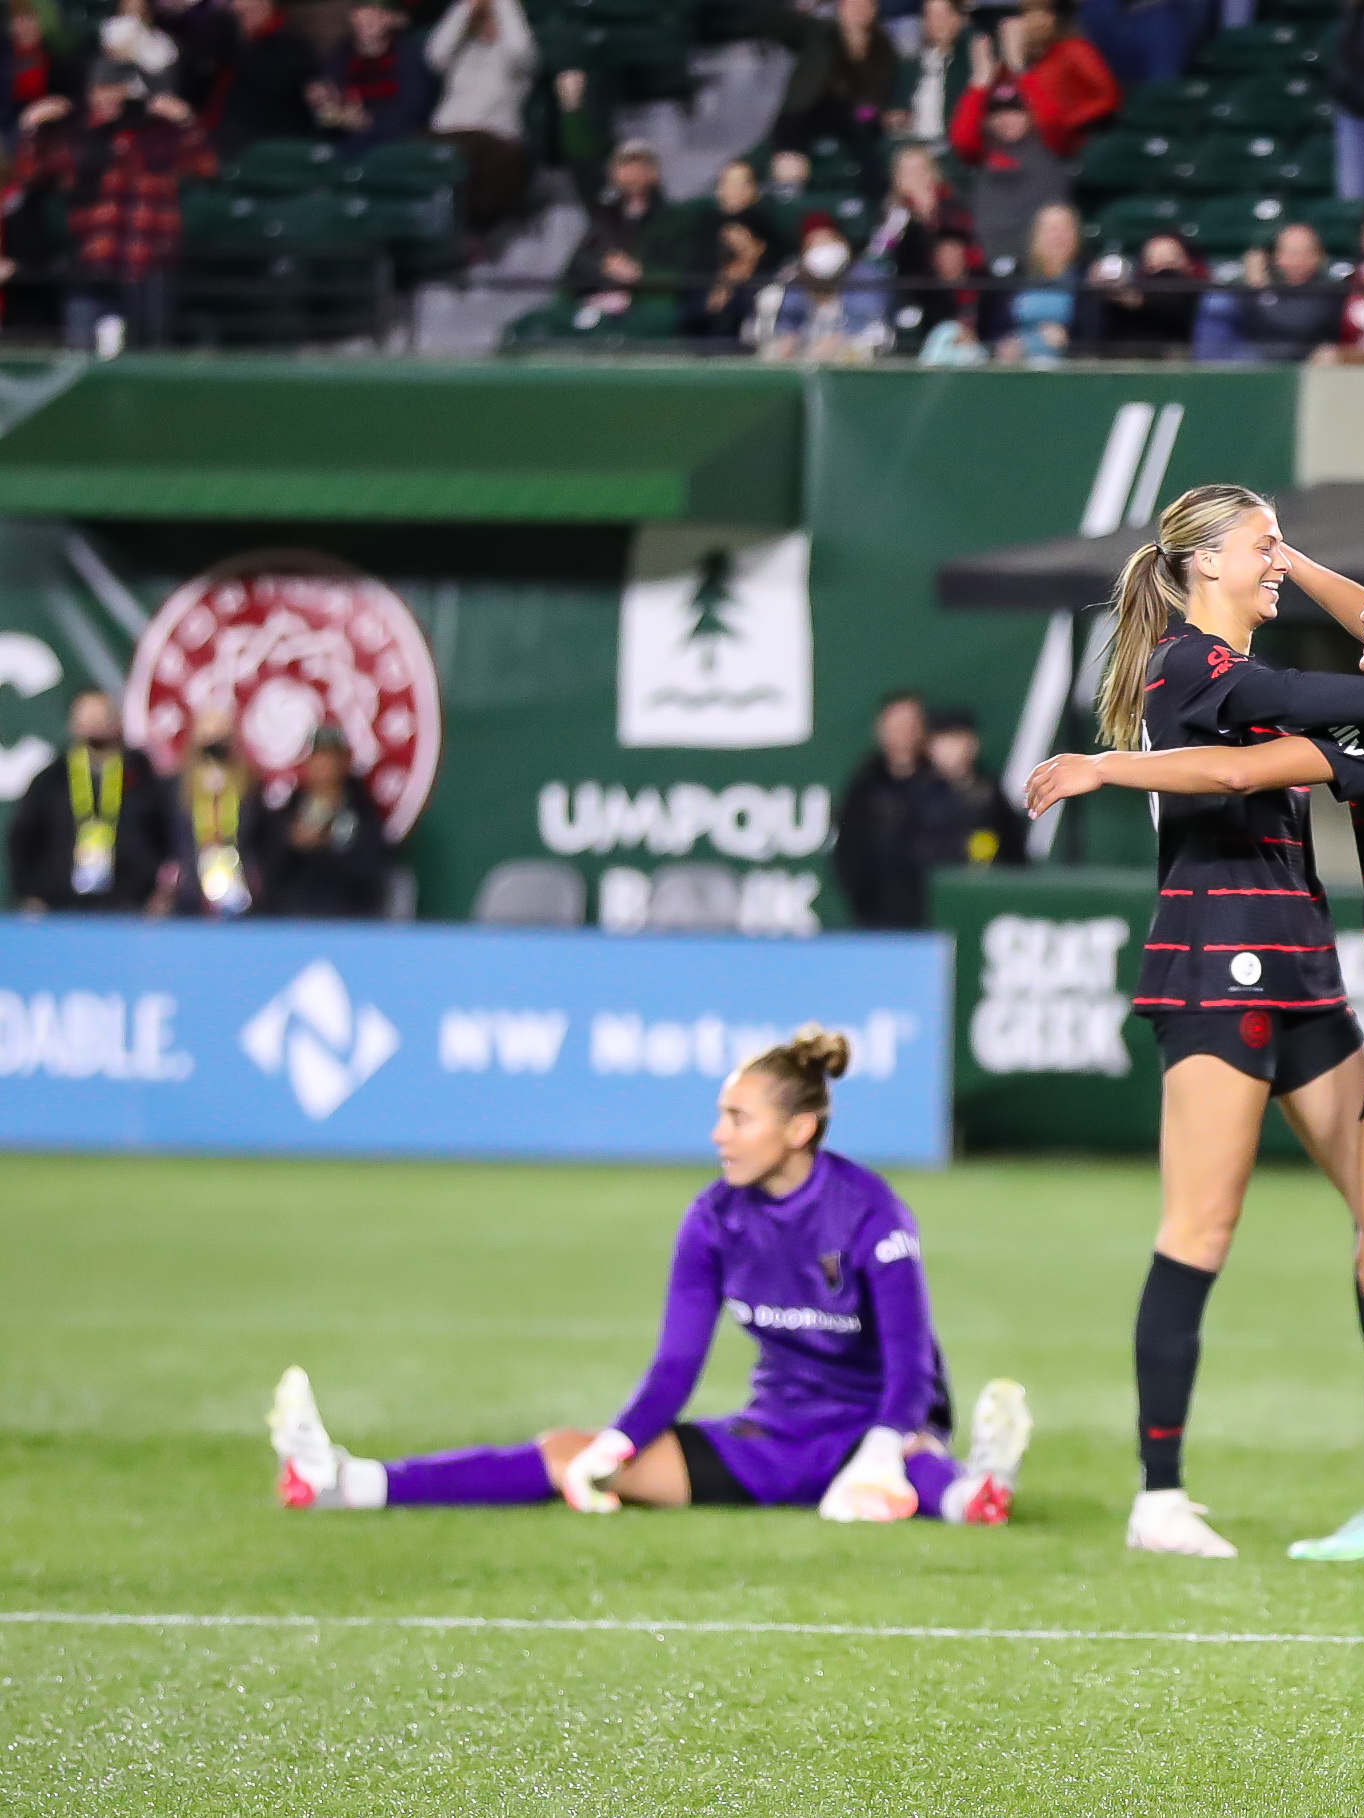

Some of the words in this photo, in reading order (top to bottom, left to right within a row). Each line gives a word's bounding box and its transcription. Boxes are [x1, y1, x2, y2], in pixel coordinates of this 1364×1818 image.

[980, 914, 1131, 992] SEAT
[439, 1009, 569, 1075] NW
[967, 996, 1133, 1079] GEEK
